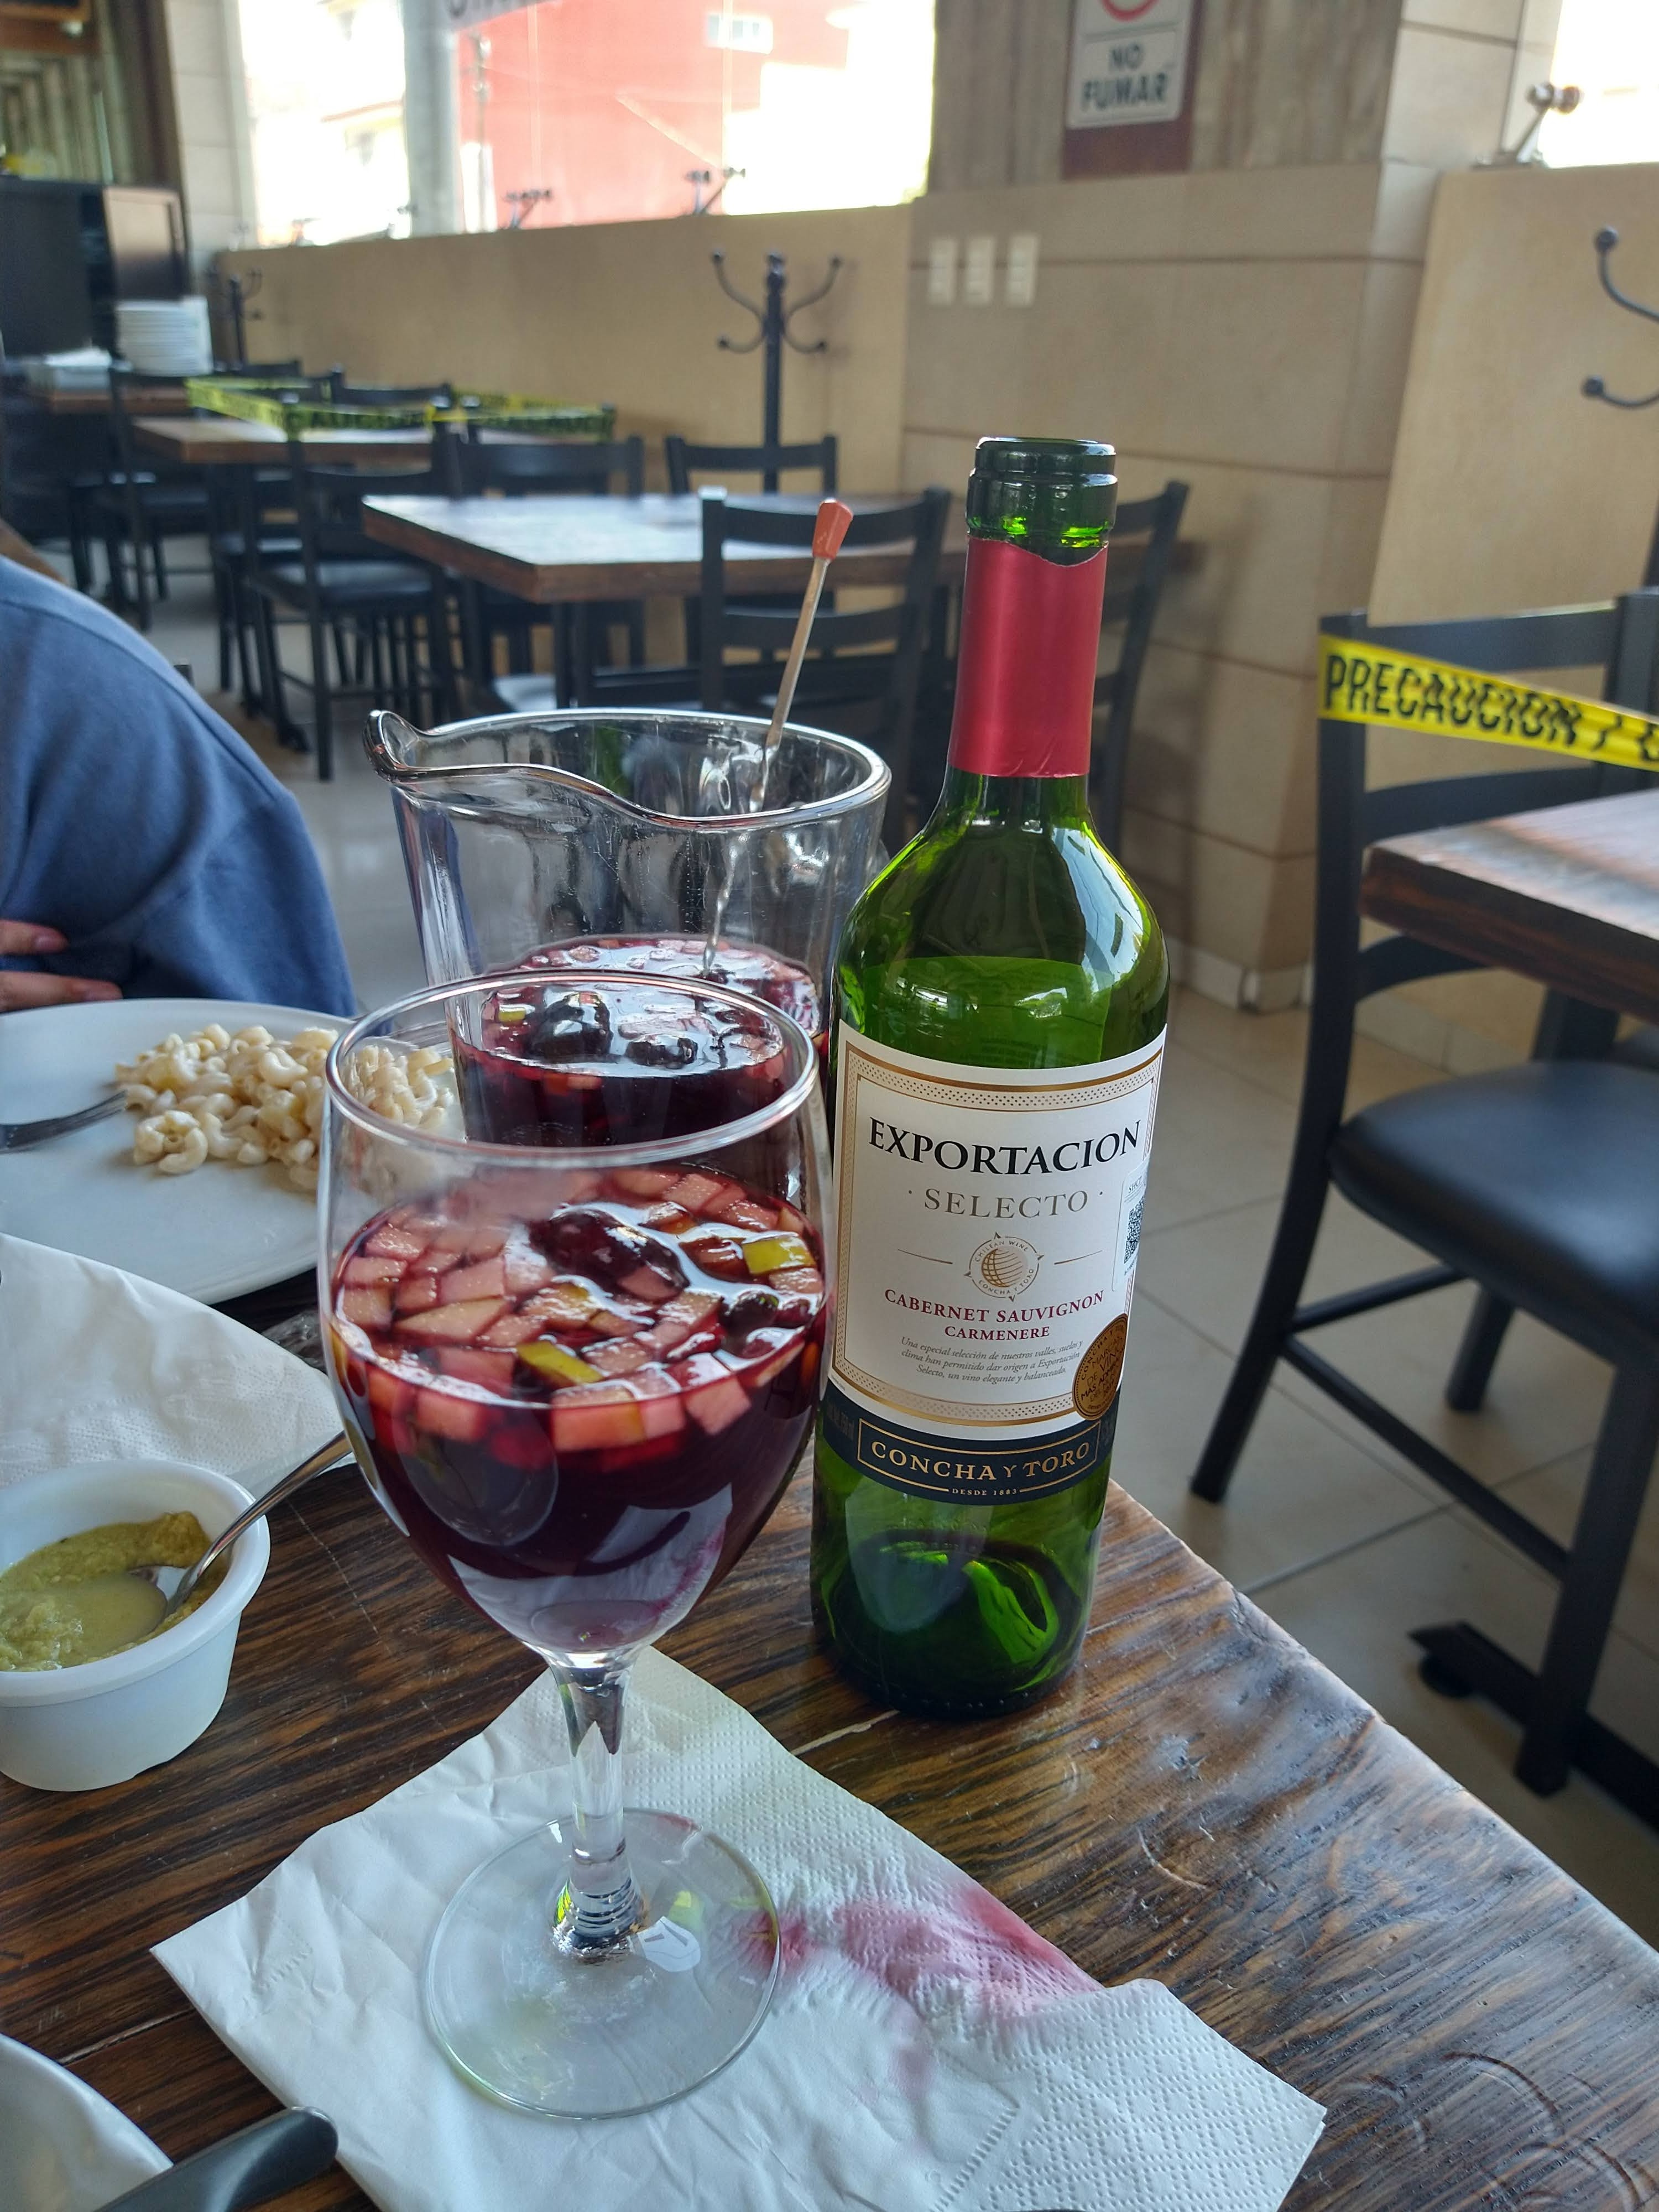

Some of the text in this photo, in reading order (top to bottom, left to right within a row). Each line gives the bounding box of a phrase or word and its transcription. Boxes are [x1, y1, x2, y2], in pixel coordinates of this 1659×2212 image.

[1110, 43, 1144, 71] NO
[1082, 72, 1167, 111] FUMAR
[869, 1117, 1141, 1175] EXPORTACION
[925, 1188, 1088, 1218] SELECTO
[975, 1240, 1029, 1262] CHILEAN WINE
[978, 1280, 1011, 1295] CONCHA
[1019, 1269, 1034, 1287] TORO
[885, 1289, 1104, 1323] CABERNET SAUVIGNON
[945, 1326, 1050, 1340] CARMENERE
[901, 1336, 918, 1349] Una
[920, 1343, 951, 1355] especial
[953, 1349, 987, 1360] selección
[989, 1351, 998, 1360] de
[1001, 1351, 1032, 1360] nuestros
[1058, 1340, 1078, 1352] suelos
[1077, 1340, 1083, 1350] y
[901, 1348, 924, 1361] clima
[925, 1355, 942, 1366] han
[942, 1360, 984, 1371] permitido
[987, 1363, 1000, 1371] dar
[1003, 1363, 1028, 1373] origen
[1038, 1352, 1080, 1368] Exportación
[916, 1364, 945, 1378] Selecto,
[962, 1373, 980, 1382] vino
[983, 1373, 1014, 1385] elegante
[1016, 1374, 1022, 1384] y
[1024, 1366, 1066, 1381] balanceado.
[872, 1441, 1090, 1481] CONCHA Y TORO
[952, 1488, 1018, 1496] DESDE 1883
